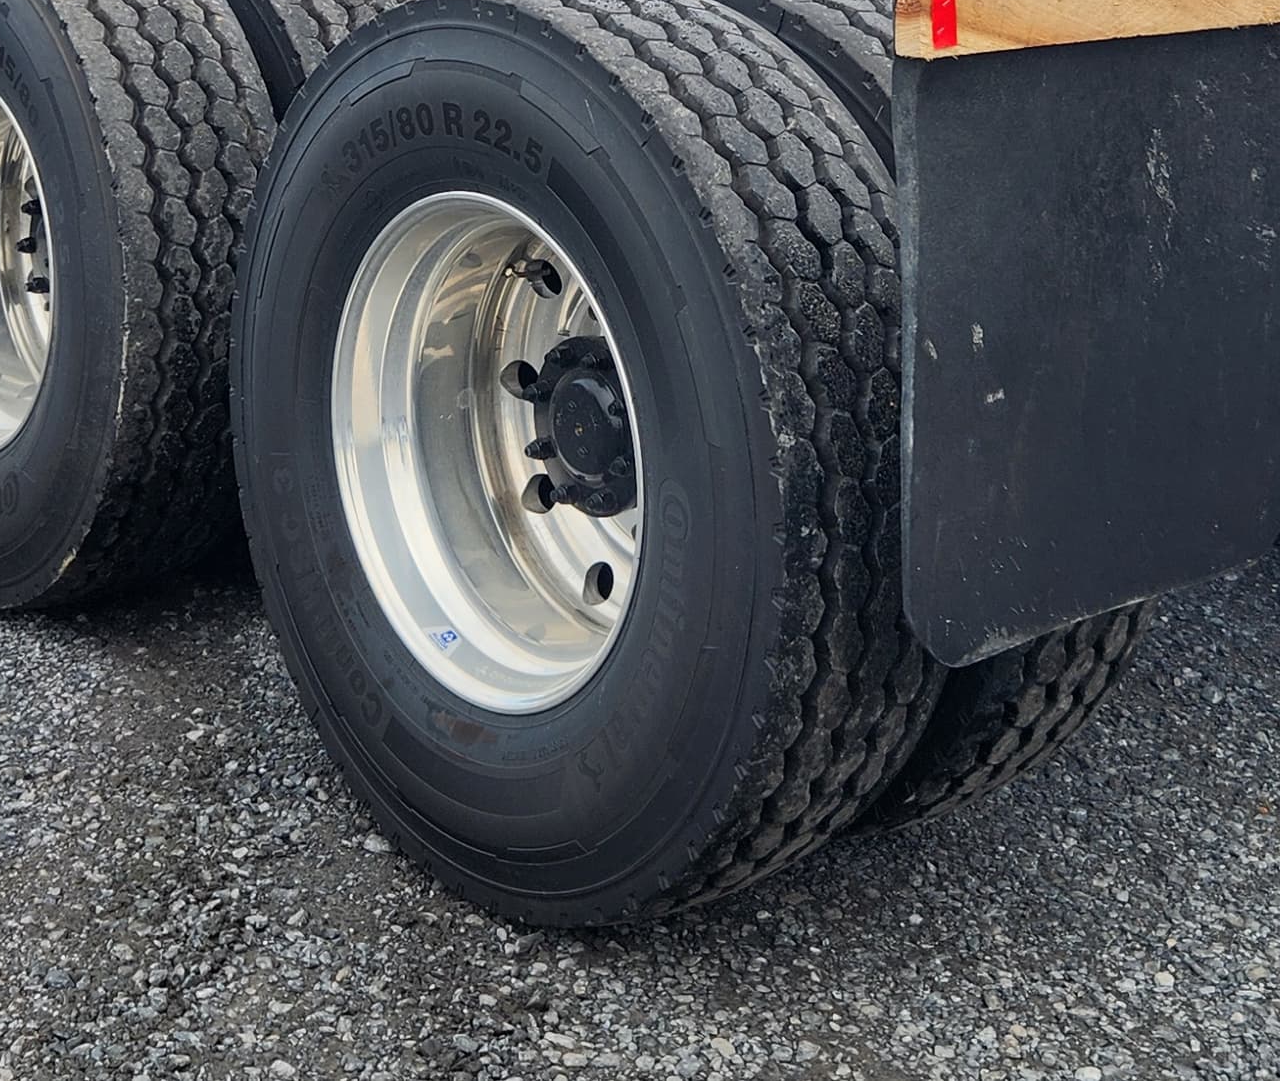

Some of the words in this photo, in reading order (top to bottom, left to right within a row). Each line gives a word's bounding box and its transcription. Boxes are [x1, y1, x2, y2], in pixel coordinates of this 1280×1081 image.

[341, 102, 435, 173] 315/80
[442, 102, 465, 138] R
[473, 109, 544, 175] 22.5
